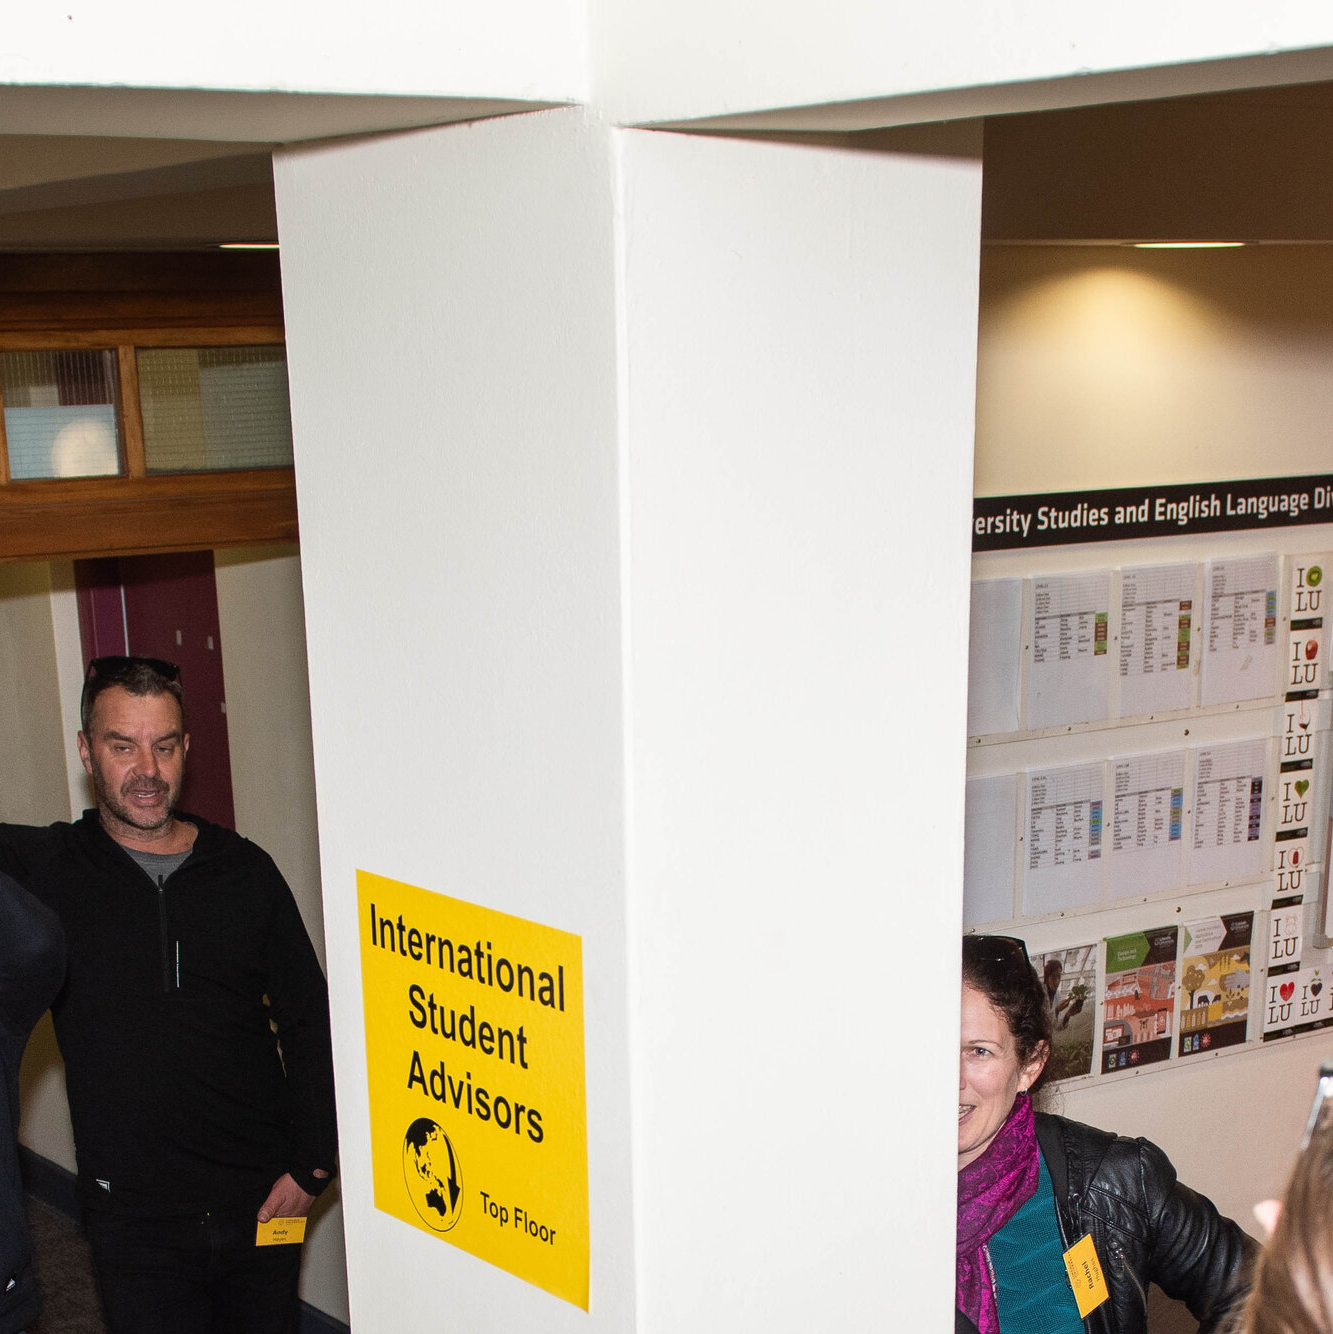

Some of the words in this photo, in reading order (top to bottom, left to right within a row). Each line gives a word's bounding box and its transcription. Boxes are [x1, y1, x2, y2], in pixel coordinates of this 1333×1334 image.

[972, 510, 1031, 536] ersity
[1037, 504, 1109, 529] Studies
[1114, 500, 1149, 525] and
[1155, 494, 1221, 525] English
[1226, 489, 1309, 518] Language
[1297, 568, 1305, 588] I
[1295, 590, 1322, 612] LU
[1293, 642, 1301, 661] I
[1291, 663, 1318, 685] LU
[1286, 714, 1295, 733] I
[1285, 734, 1312, 756] LU
[1283, 783, 1291, 801] I
[1282, 802, 1307, 824] LU
[1278, 851, 1286, 869] I
[1277, 870, 1303, 892] LU
[1274, 919, 1282, 937] I
[370, 902, 565, 1012] International
[1272, 937, 1298, 959] LU
[1270, 986, 1278, 1003] I
[1302, 986, 1308, 1000] I
[1268, 1003, 1293, 1024] LU
[1300, 1000, 1321, 1017] LU
[408, 983, 529, 1070] Student
[407, 1050, 544, 1143] Advisors
[480, 1191, 509, 1227] Top
[515, 1208, 556, 1245] Floor
[1082, 1261, 1094, 1289] Rachel
